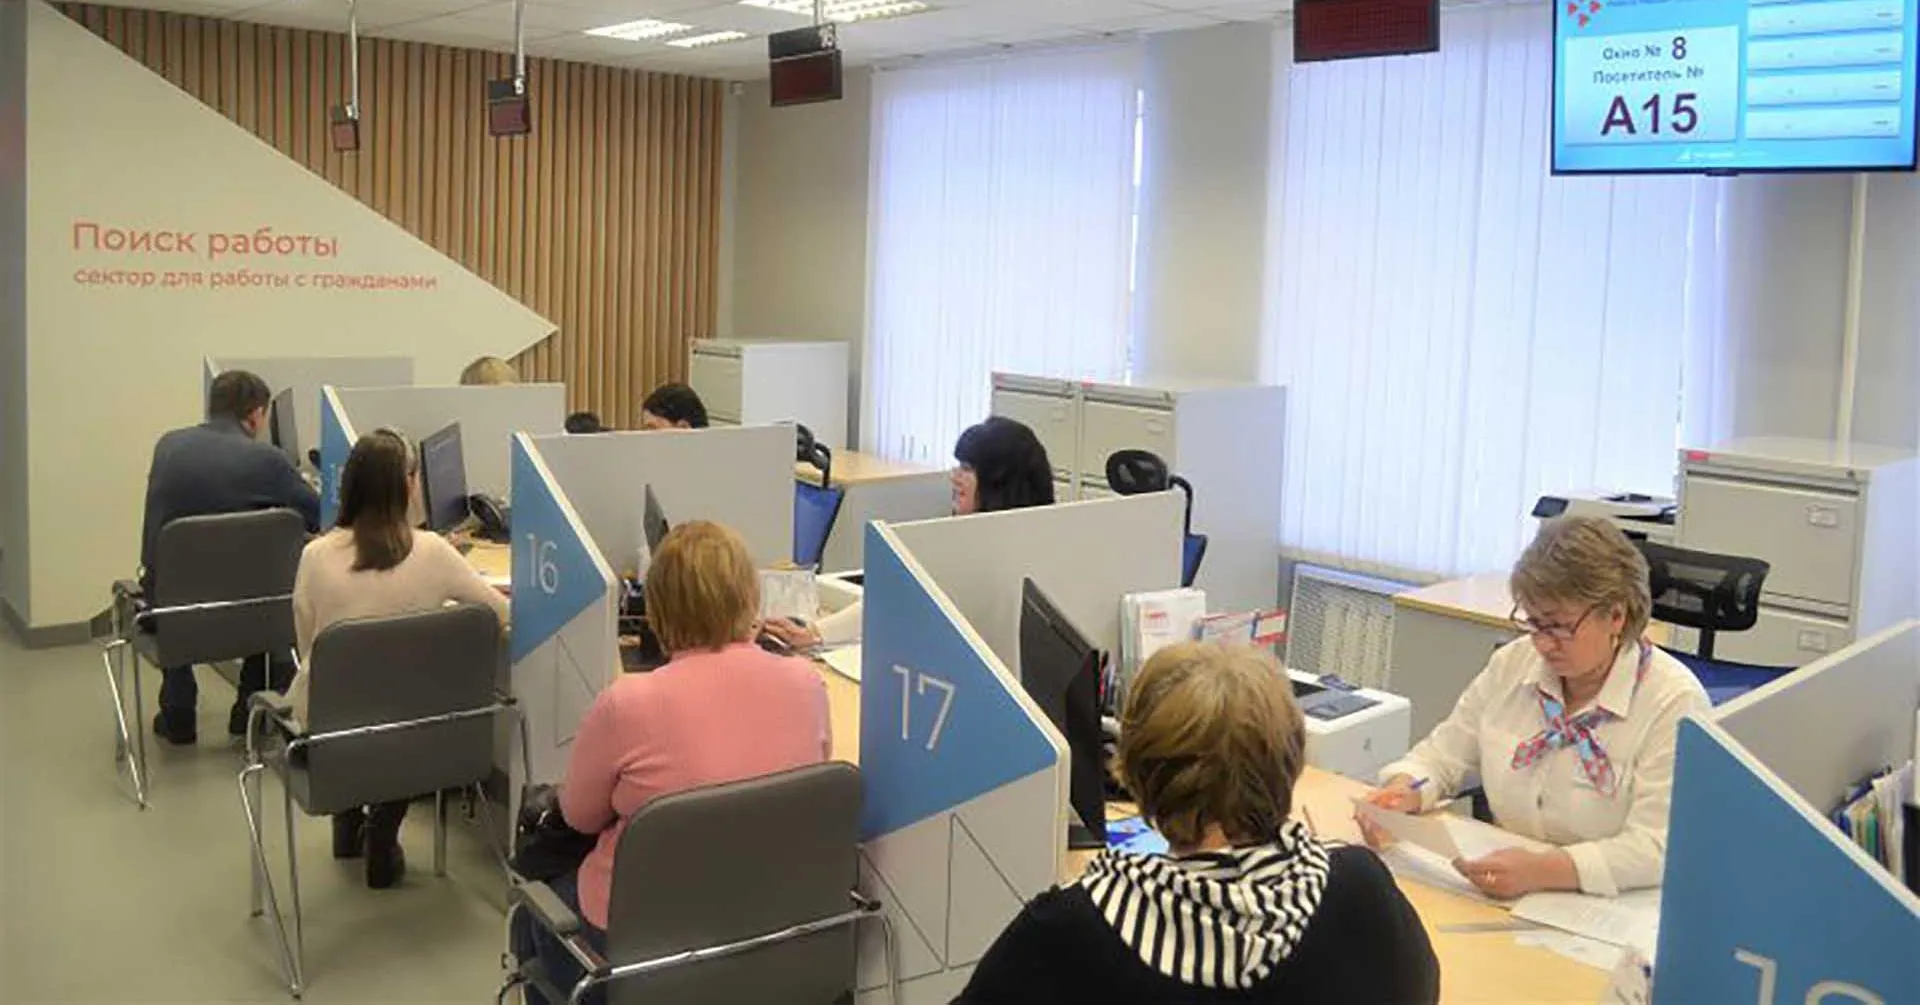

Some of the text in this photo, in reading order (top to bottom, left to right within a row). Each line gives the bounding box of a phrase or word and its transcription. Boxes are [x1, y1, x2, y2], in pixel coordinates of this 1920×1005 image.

[1672, 36, 1687, 60] 8
[73, 222, 338, 260] Поиск работы
[73, 268, 438, 291] сектор для работы с гражданами
[525, 532, 559, 595] 16
[892, 664, 955, 752] 17
[1733, 947, 1887, 1005] 1
